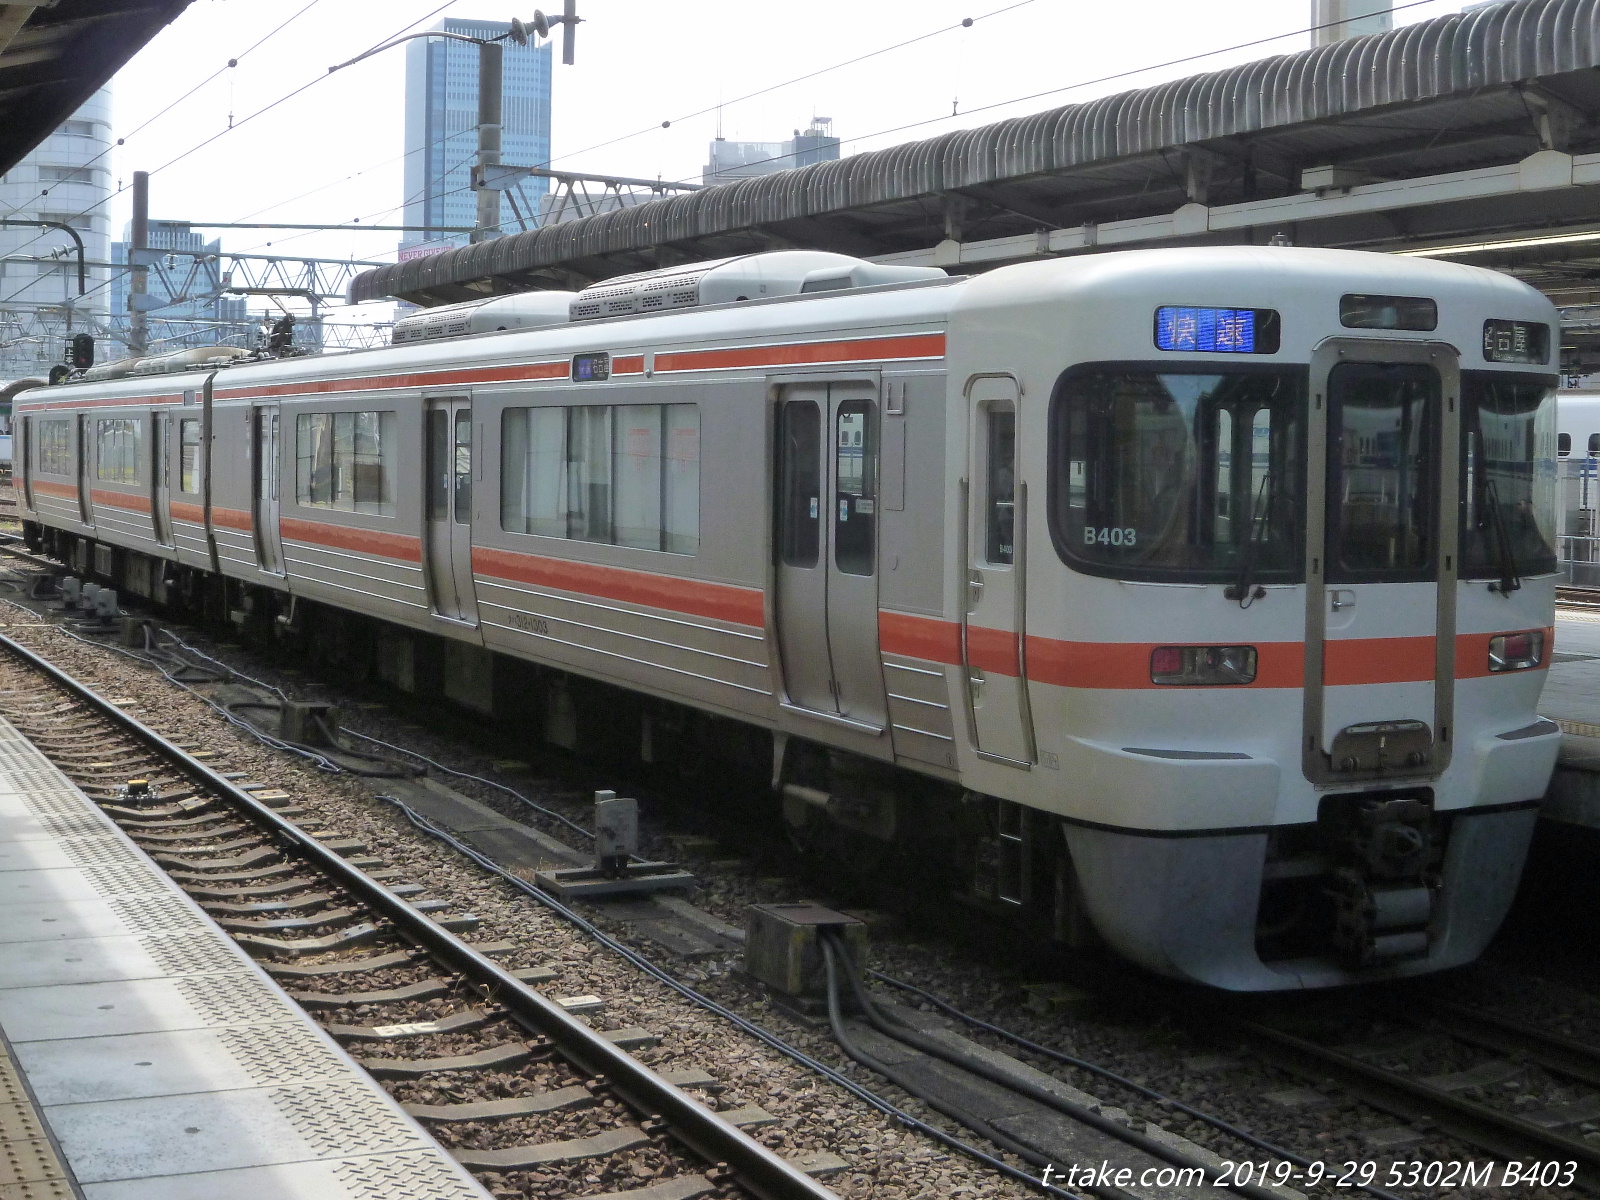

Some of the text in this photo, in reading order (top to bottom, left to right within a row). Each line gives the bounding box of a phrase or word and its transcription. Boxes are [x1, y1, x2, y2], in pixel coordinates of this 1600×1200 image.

[399, 250, 423, 261] NEVER
[1167, 313, 1246, 345] 快速
[1083, 526, 1137, 546] B403
